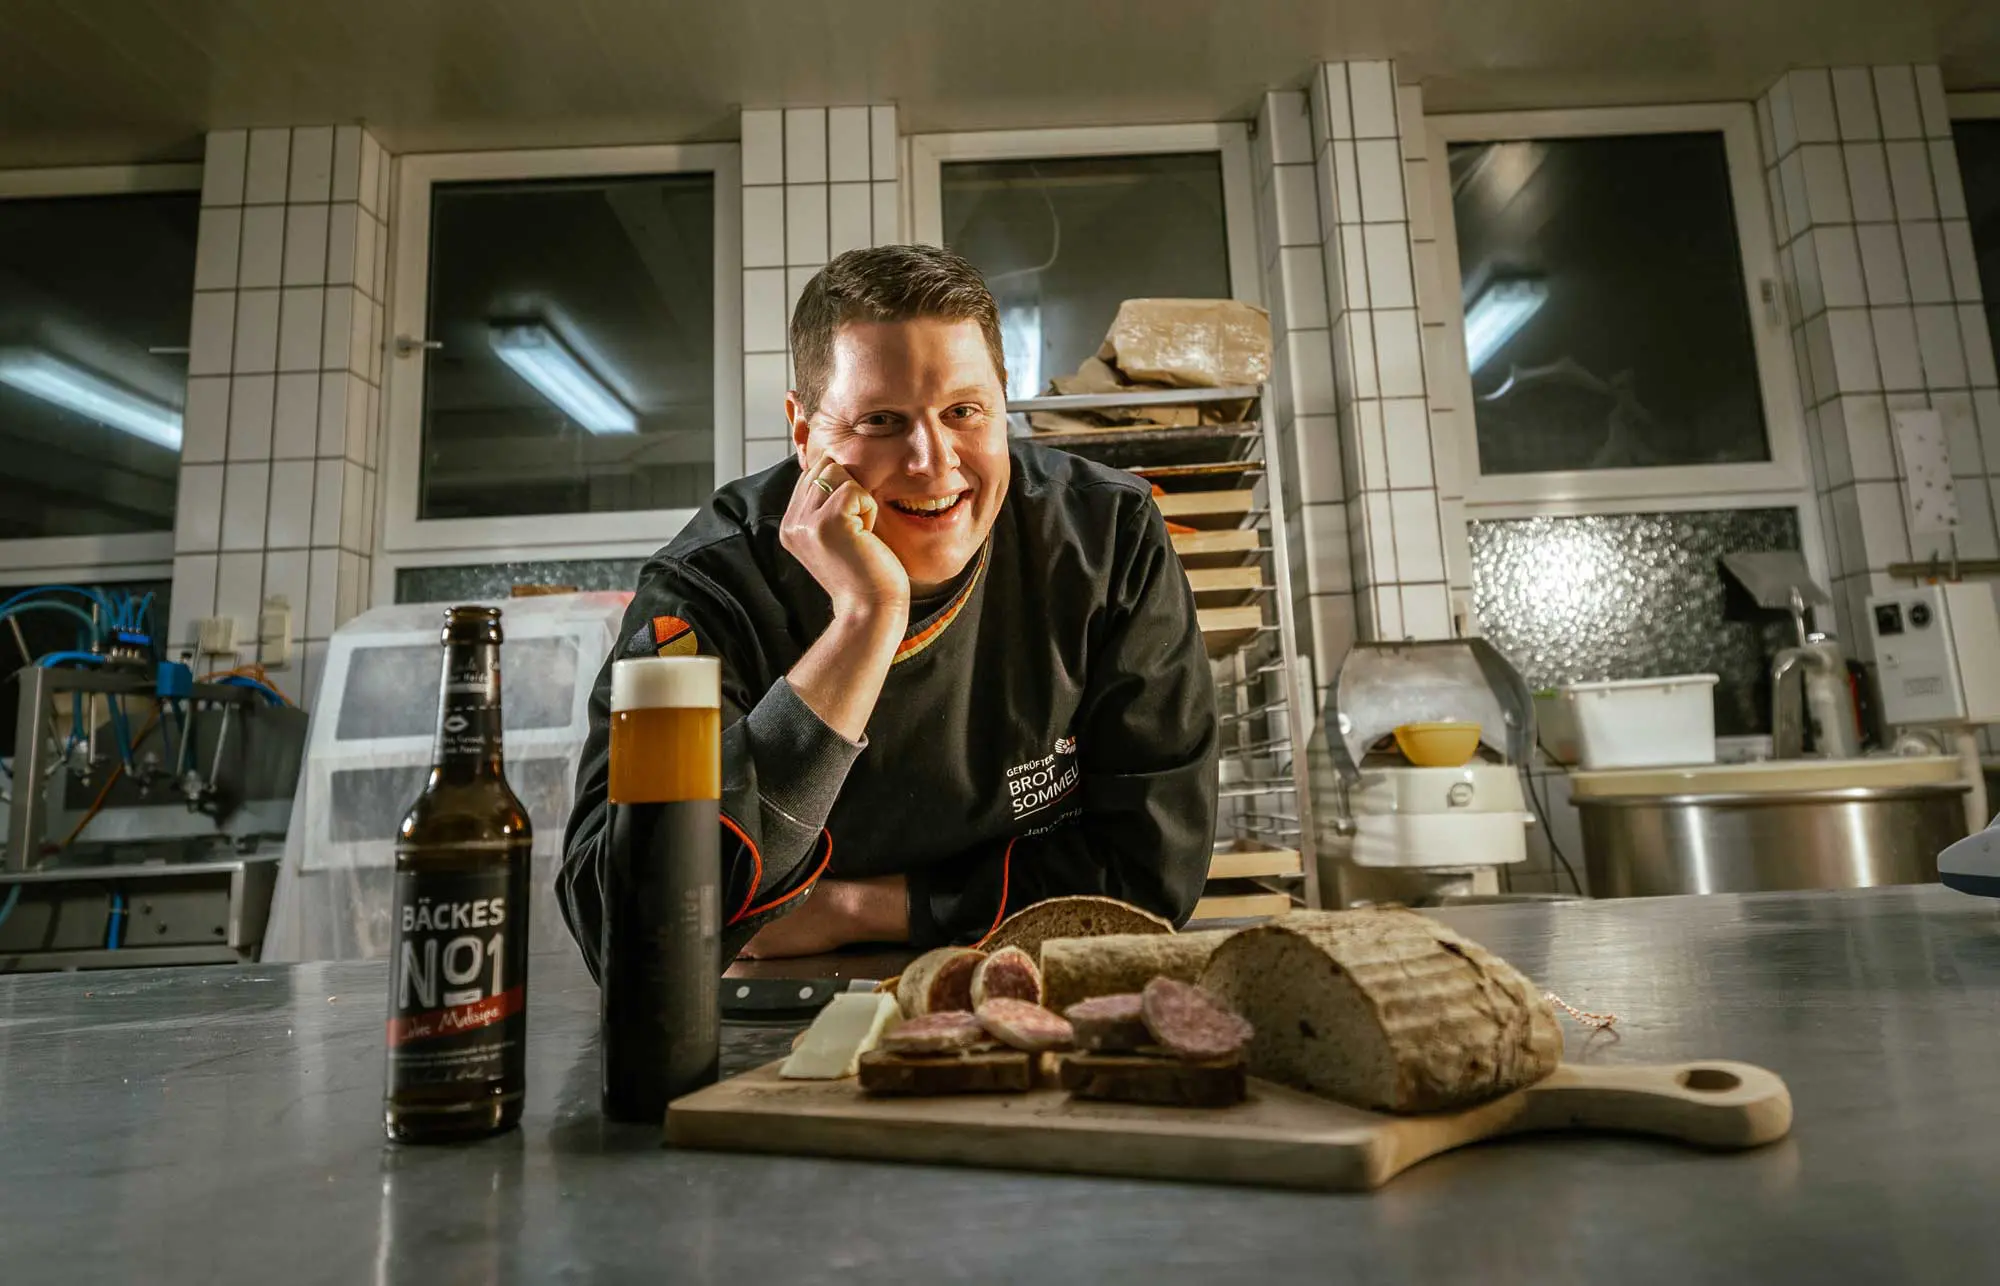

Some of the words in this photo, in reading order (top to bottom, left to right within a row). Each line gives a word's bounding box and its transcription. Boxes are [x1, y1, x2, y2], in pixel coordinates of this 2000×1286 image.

[1006, 754, 1055, 777] GEPRÜFTER
[1008, 764, 1056, 797] BROT
[402, 897, 506, 932] BÄCKES
